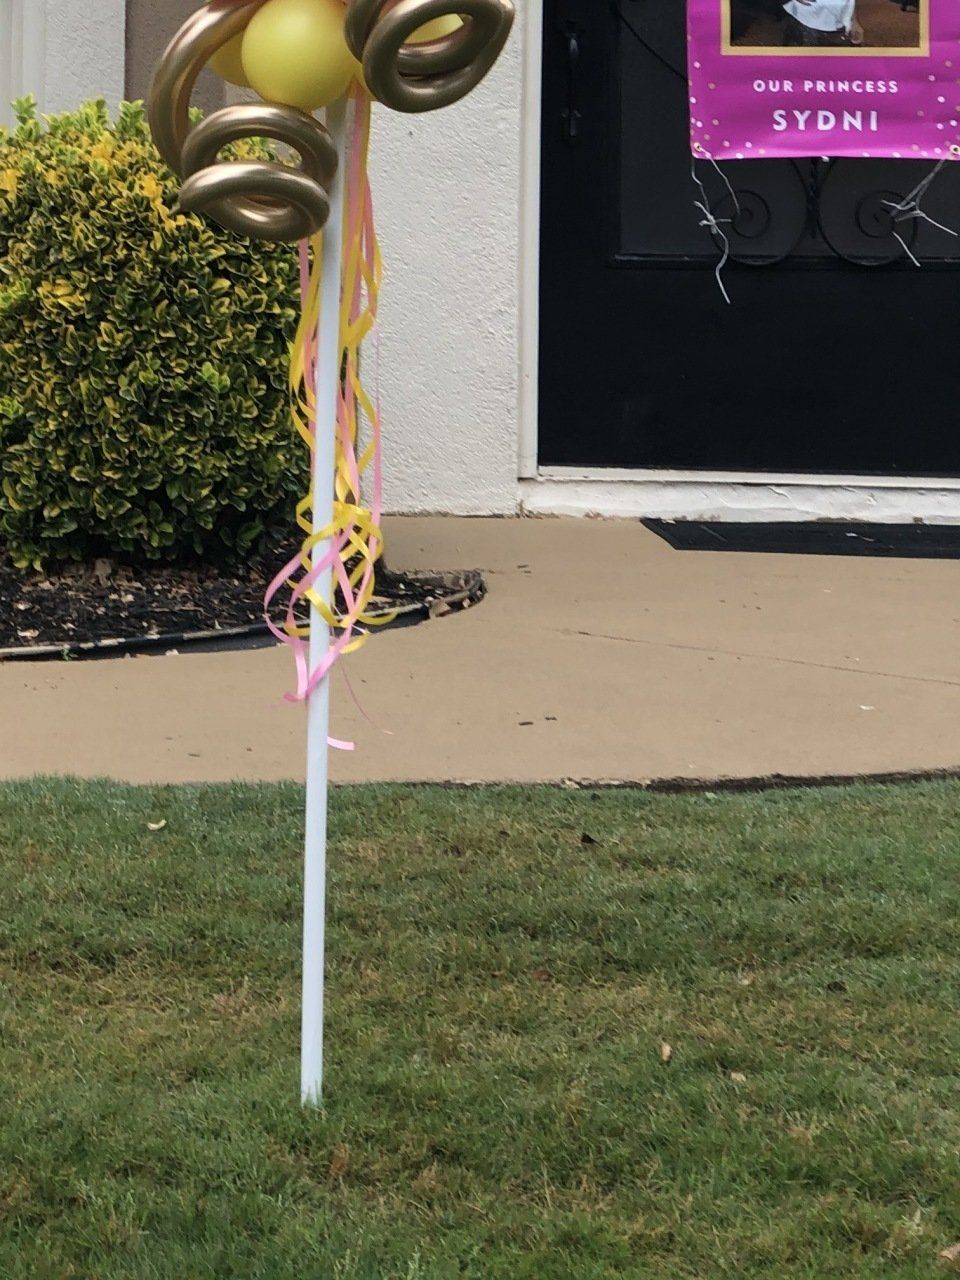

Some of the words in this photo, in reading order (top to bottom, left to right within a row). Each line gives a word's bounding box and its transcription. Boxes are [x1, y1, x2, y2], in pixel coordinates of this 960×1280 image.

[753, 79, 794, 93] OUR
[803, 80, 899, 94] PRINCESS
[772, 109, 879, 132] SYDNI
